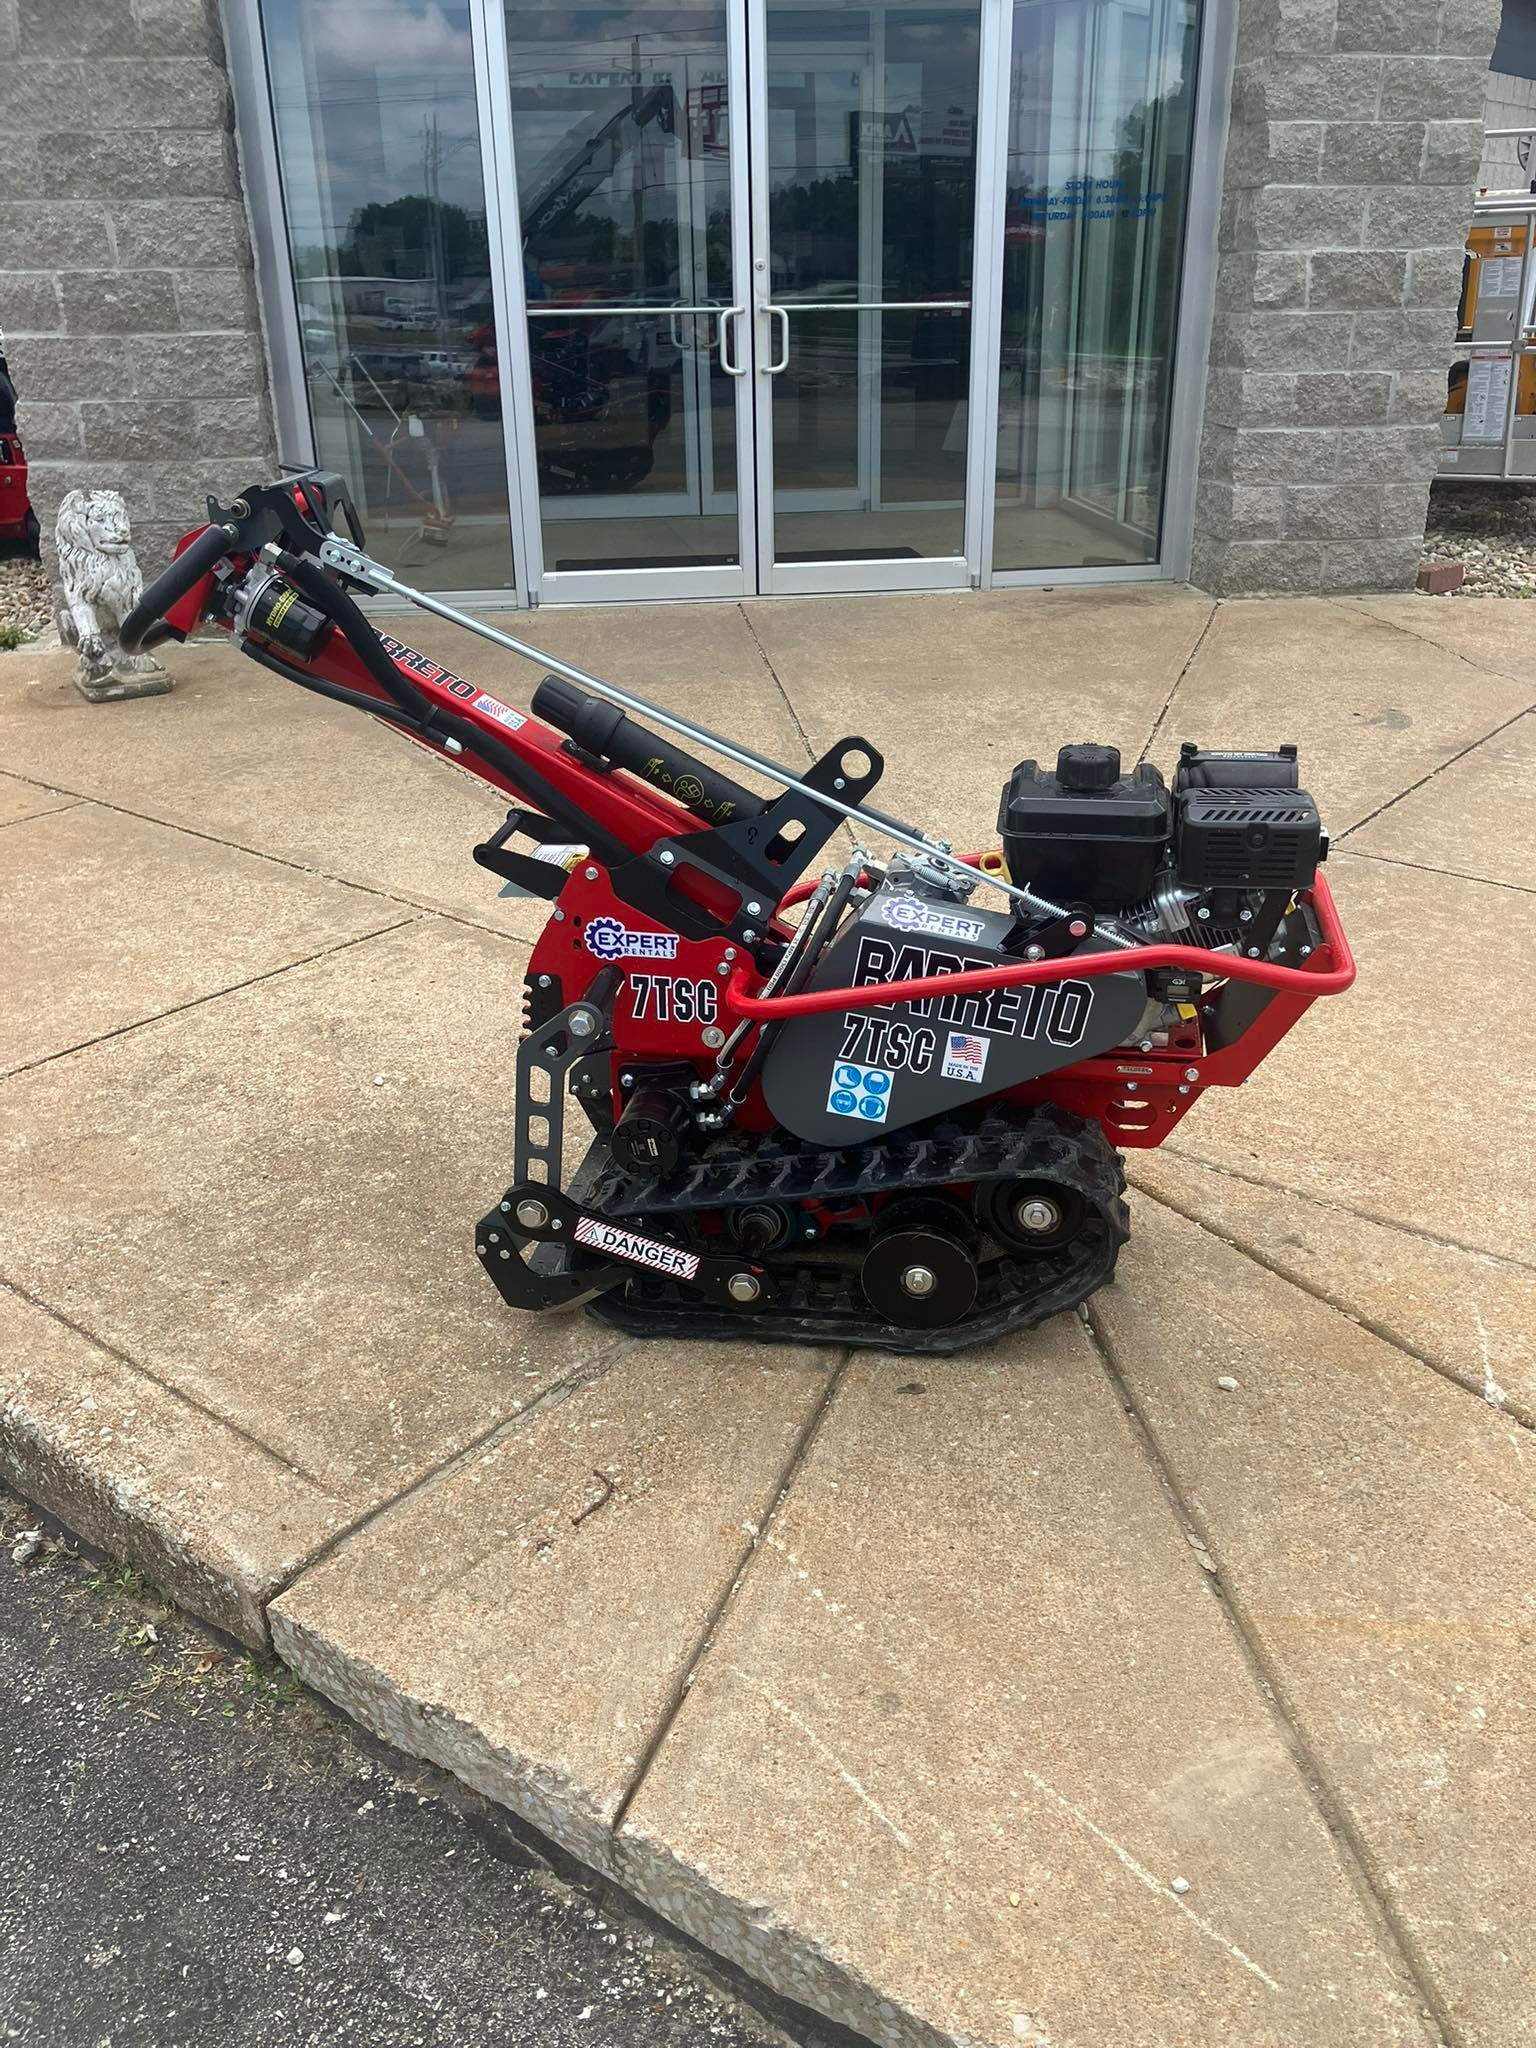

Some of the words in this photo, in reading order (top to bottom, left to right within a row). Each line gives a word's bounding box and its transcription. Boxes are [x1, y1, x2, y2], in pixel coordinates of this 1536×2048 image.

[896, 907, 983, 934] EXPERT
[921, 923, 977, 940] RENTALS
[598, 932, 678, 950] EXPERT
[624, 948, 675, 957] RENTALS
[630, 973, 718, 1025] 7TSC
[838, 1013, 937, 1075] 7TSC
[946, 1066, 977, 1081] U.S.A.
[602, 1231, 687, 1272] DANGER
